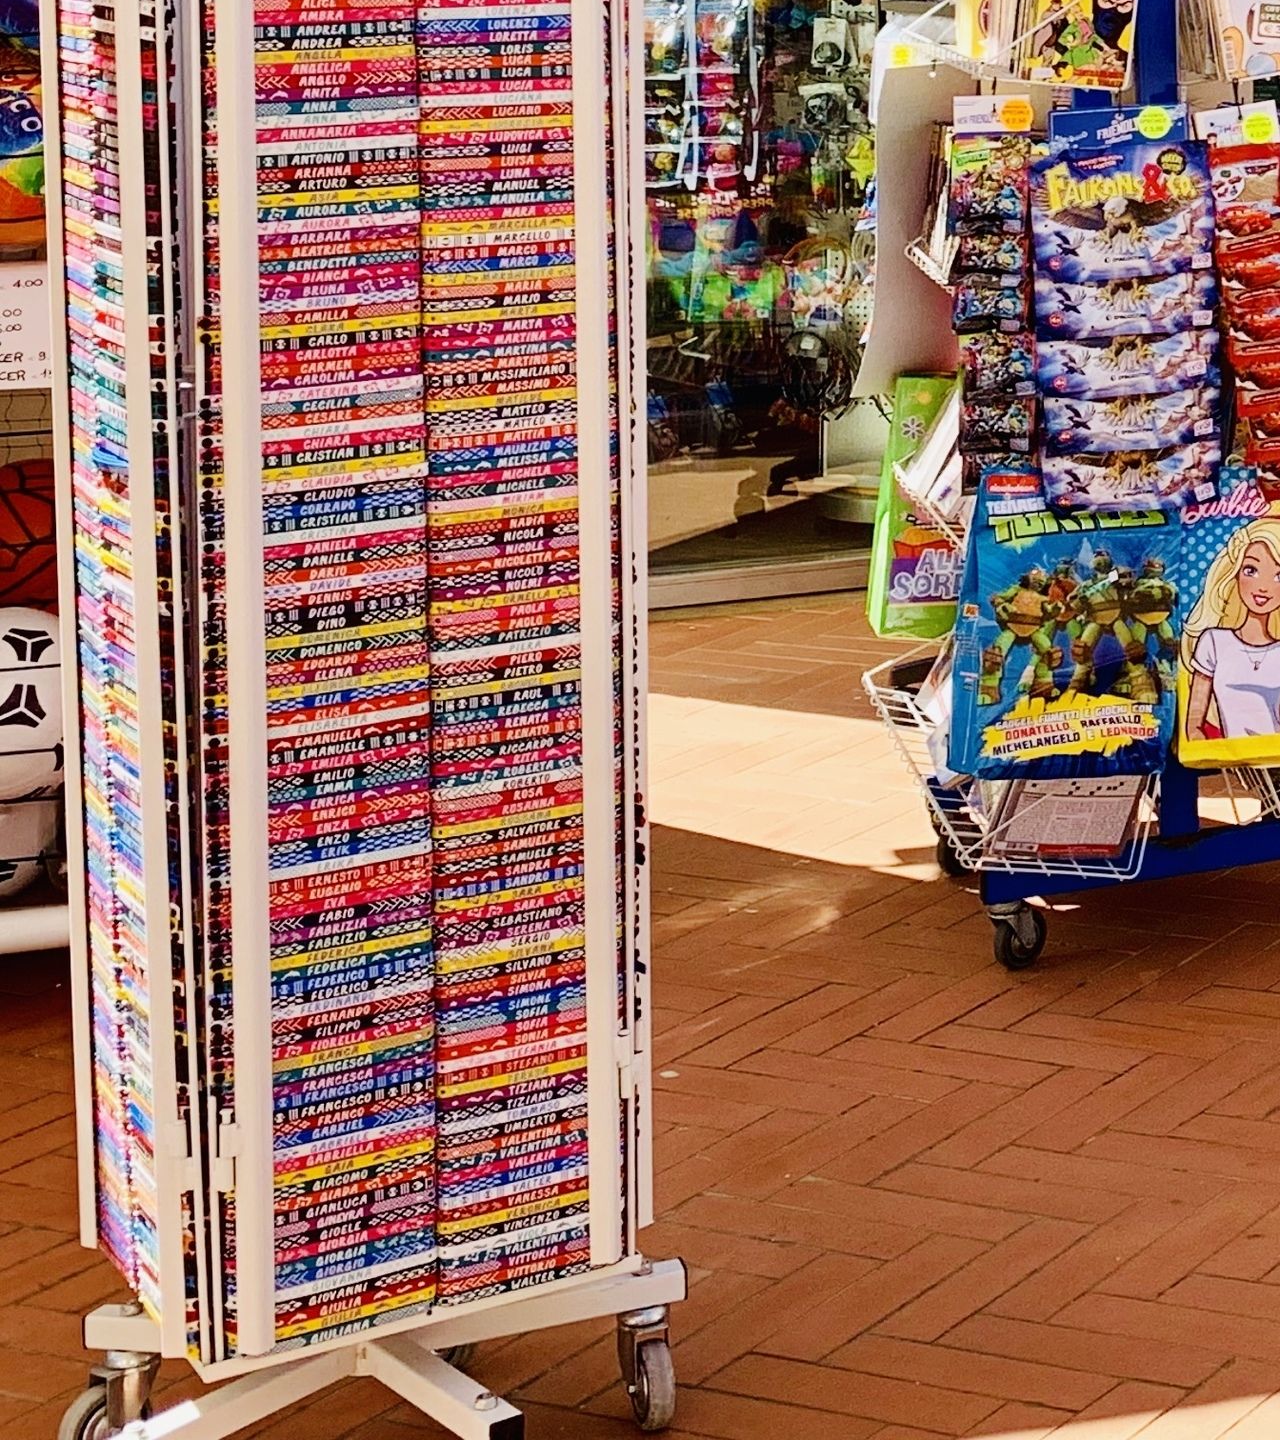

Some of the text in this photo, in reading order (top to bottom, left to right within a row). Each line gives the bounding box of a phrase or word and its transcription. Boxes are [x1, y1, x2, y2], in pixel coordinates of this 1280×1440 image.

[297, 23, 346, 36] ANDREA
[487, 17, 539, 30] LORENZO
[501, 43, 534, 55] LORIS
[299, 74, 346, 85] ANGELO
[494, 105, 541, 117] LUCIANO
[281, 125, 356, 140] ANNAMARIA
[291, 152, 343, 164] ANTONIO
[493, 179, 539, 192] MANUEL
[1143, 164, 1171, 203] &
[296, 204, 346, 217] AURORA
[291, 230, 351, 244] BARBARA
[494, 230, 550, 242] MARCELLO
[288, 256, 356, 271] BENEDETTA
[503, 293, 540, 305] MARIO
[308, 334, 348, 346] CARLO
[481, 364, 565, 382] MASSIMILIANO
[296, 447, 354, 462] CRISTIAN
[496, 478, 545, 492] MICHELE
[503, 527, 544, 540] NICOLA
[302, 552, 354, 566] DANIELE
[308, 590, 352, 603] DENNIS
[499, 625, 551, 641] PATRIZIO
[300, 641, 362, 657] DOMENICO
[513, 688, 543, 700] RAUL
[1132, 704, 1153, 714] CON
[300, 739, 365, 759] EMANUELE
[500, 736, 554, 755] RICCARDO
[993, 732, 1080, 756] MICHELANGELO
[498, 819, 560, 840] SALVATORE
[501, 848, 554, 866] SAMUELE
[318, 908, 355, 922] FABIO
[493, 906, 562, 927] SEBASTIANO
[308, 929, 367, 950] FABRIZIO
[310, 979, 369, 1000] FEDERICO
[301, 1092, 372, 1116] FRANCESCO
[503, 1112, 556, 1133] UMBERTO
[312, 1168, 368, 1189] GIACOMO
[305, 1195, 368, 1217] GIANLUCA
[503, 1210, 560, 1233] VINCENZO
[505, 1233, 567, 1256] VALENTINA
[511, 1270, 555, 1290] WALTER
[309, 1282, 368, 1306] GIOVANNI
